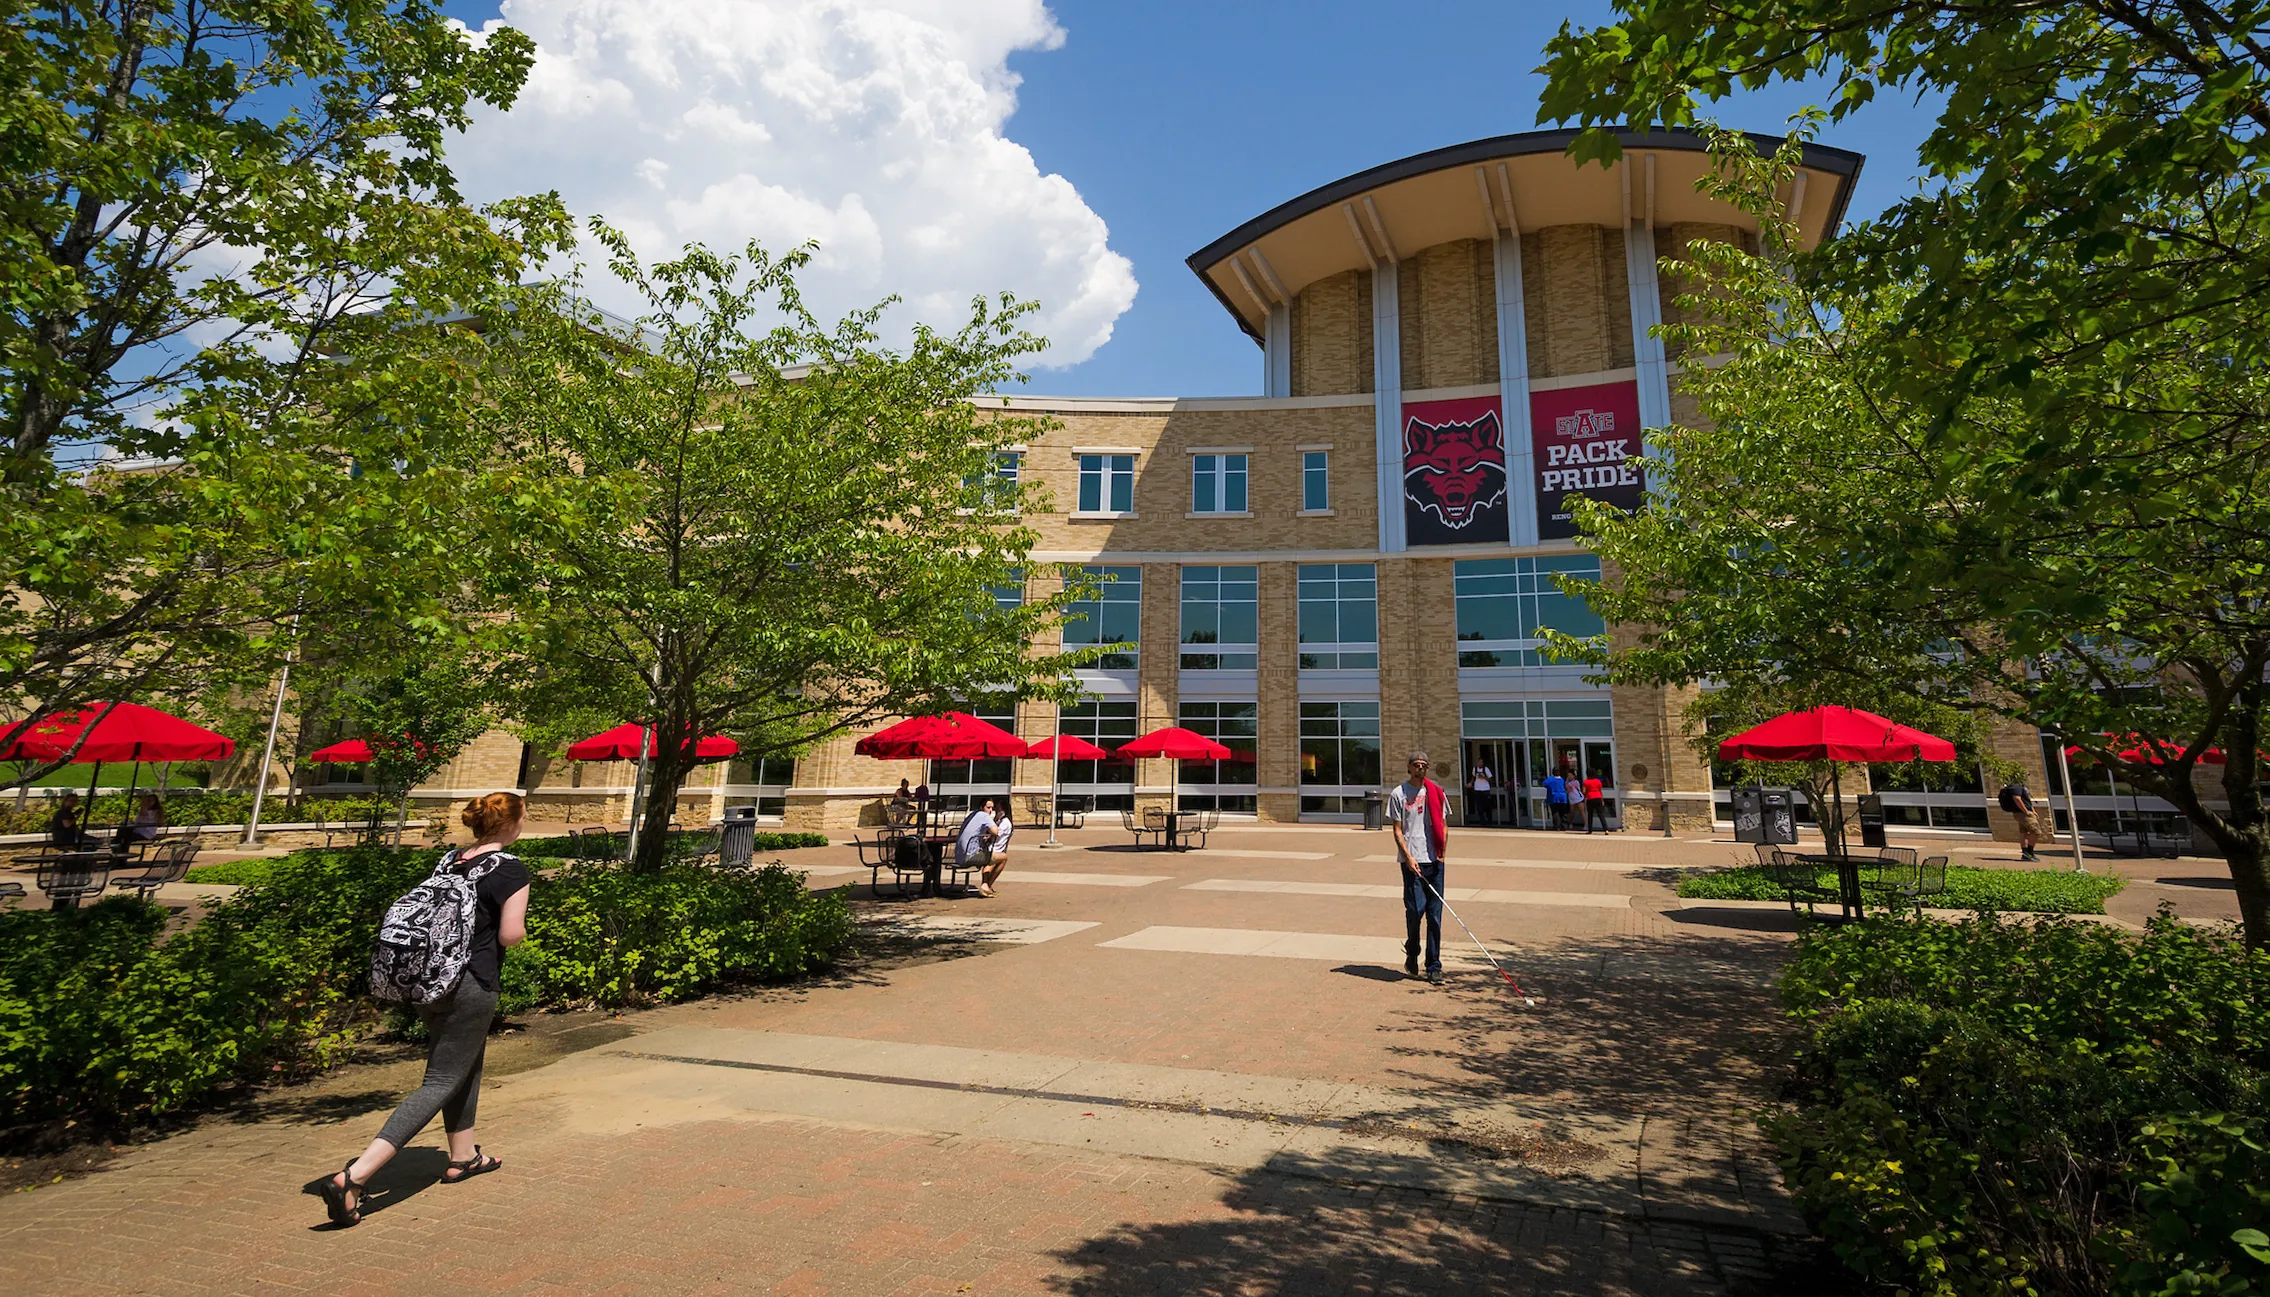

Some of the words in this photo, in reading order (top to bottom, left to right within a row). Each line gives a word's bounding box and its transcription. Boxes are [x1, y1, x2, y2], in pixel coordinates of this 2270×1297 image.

[1556, 409, 1614, 439] STATE
[1547, 439, 1628, 466] PACK
[1541, 464, 1638, 492] PRIDE
[1552, 513, 1571, 521] RENG
